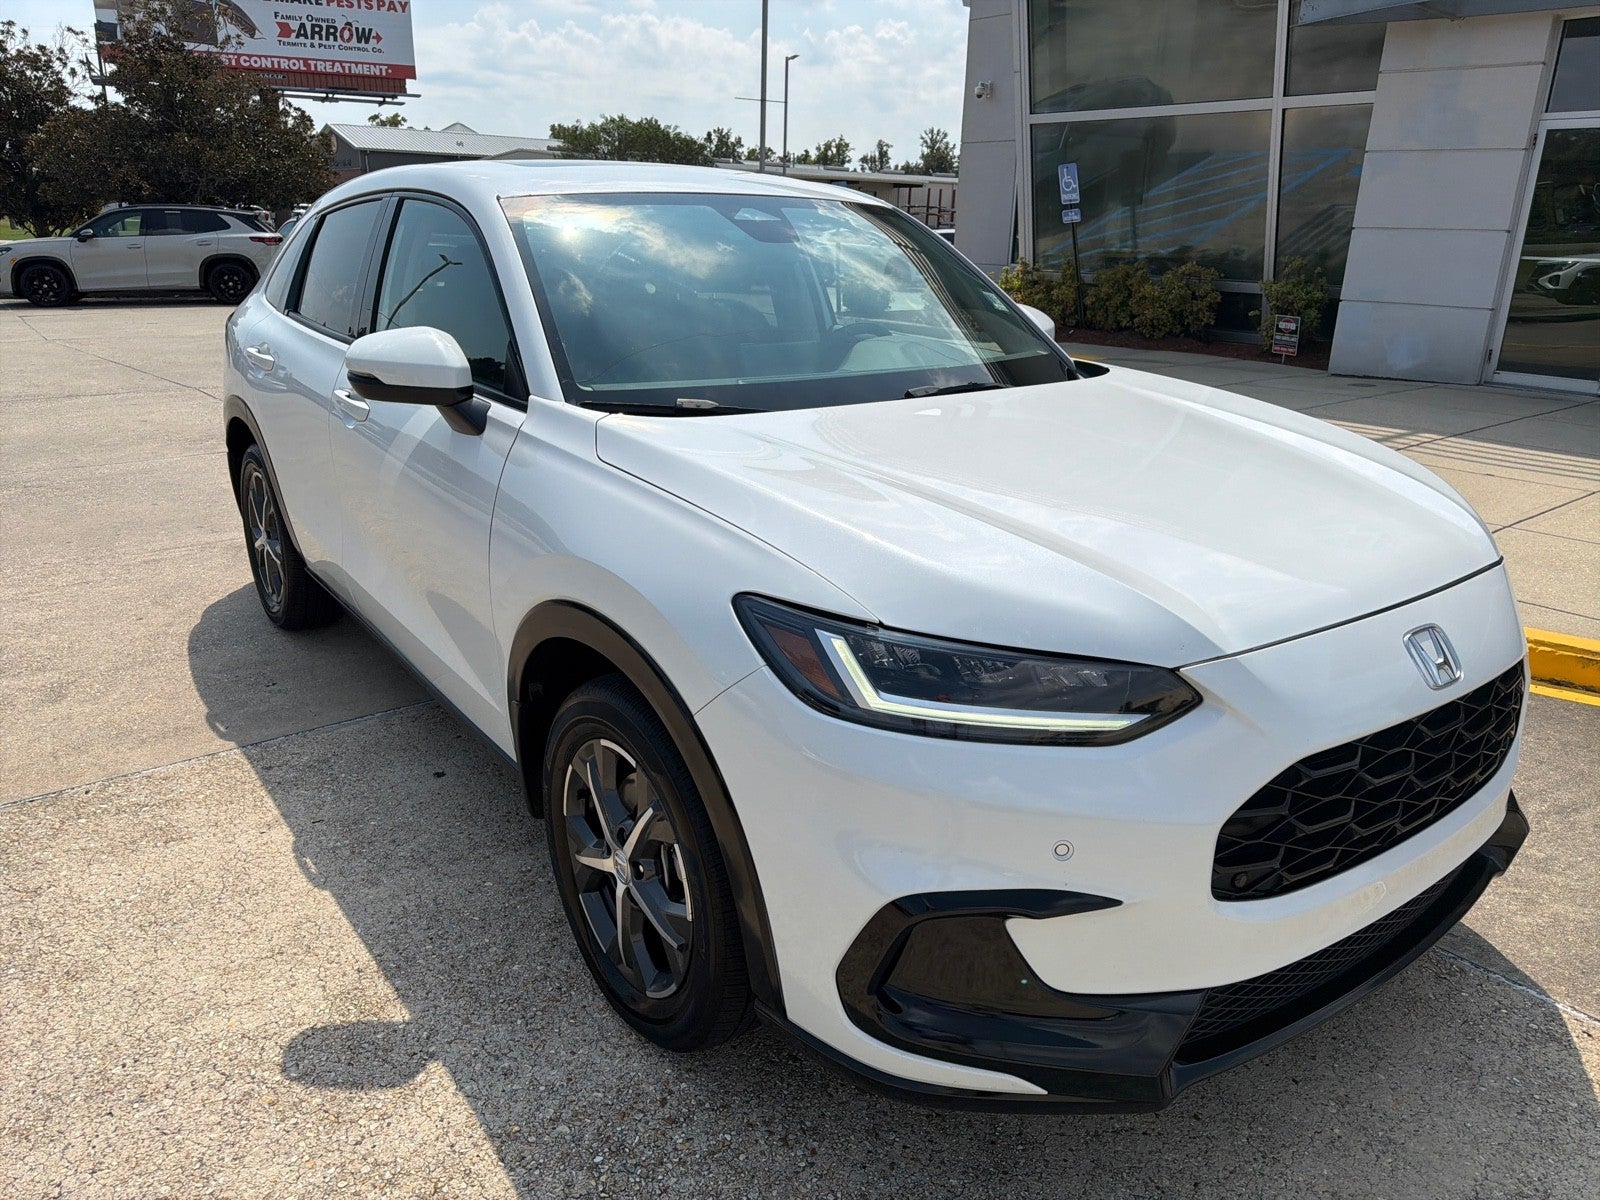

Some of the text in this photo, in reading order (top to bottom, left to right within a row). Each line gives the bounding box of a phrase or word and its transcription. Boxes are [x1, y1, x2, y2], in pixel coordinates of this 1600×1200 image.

[376, 0, 408, 13] PAY
[306, 14, 336, 24] OWNED
[295, 22, 373, 44] ARROW
[240, 55, 307, 70] CONTROL
